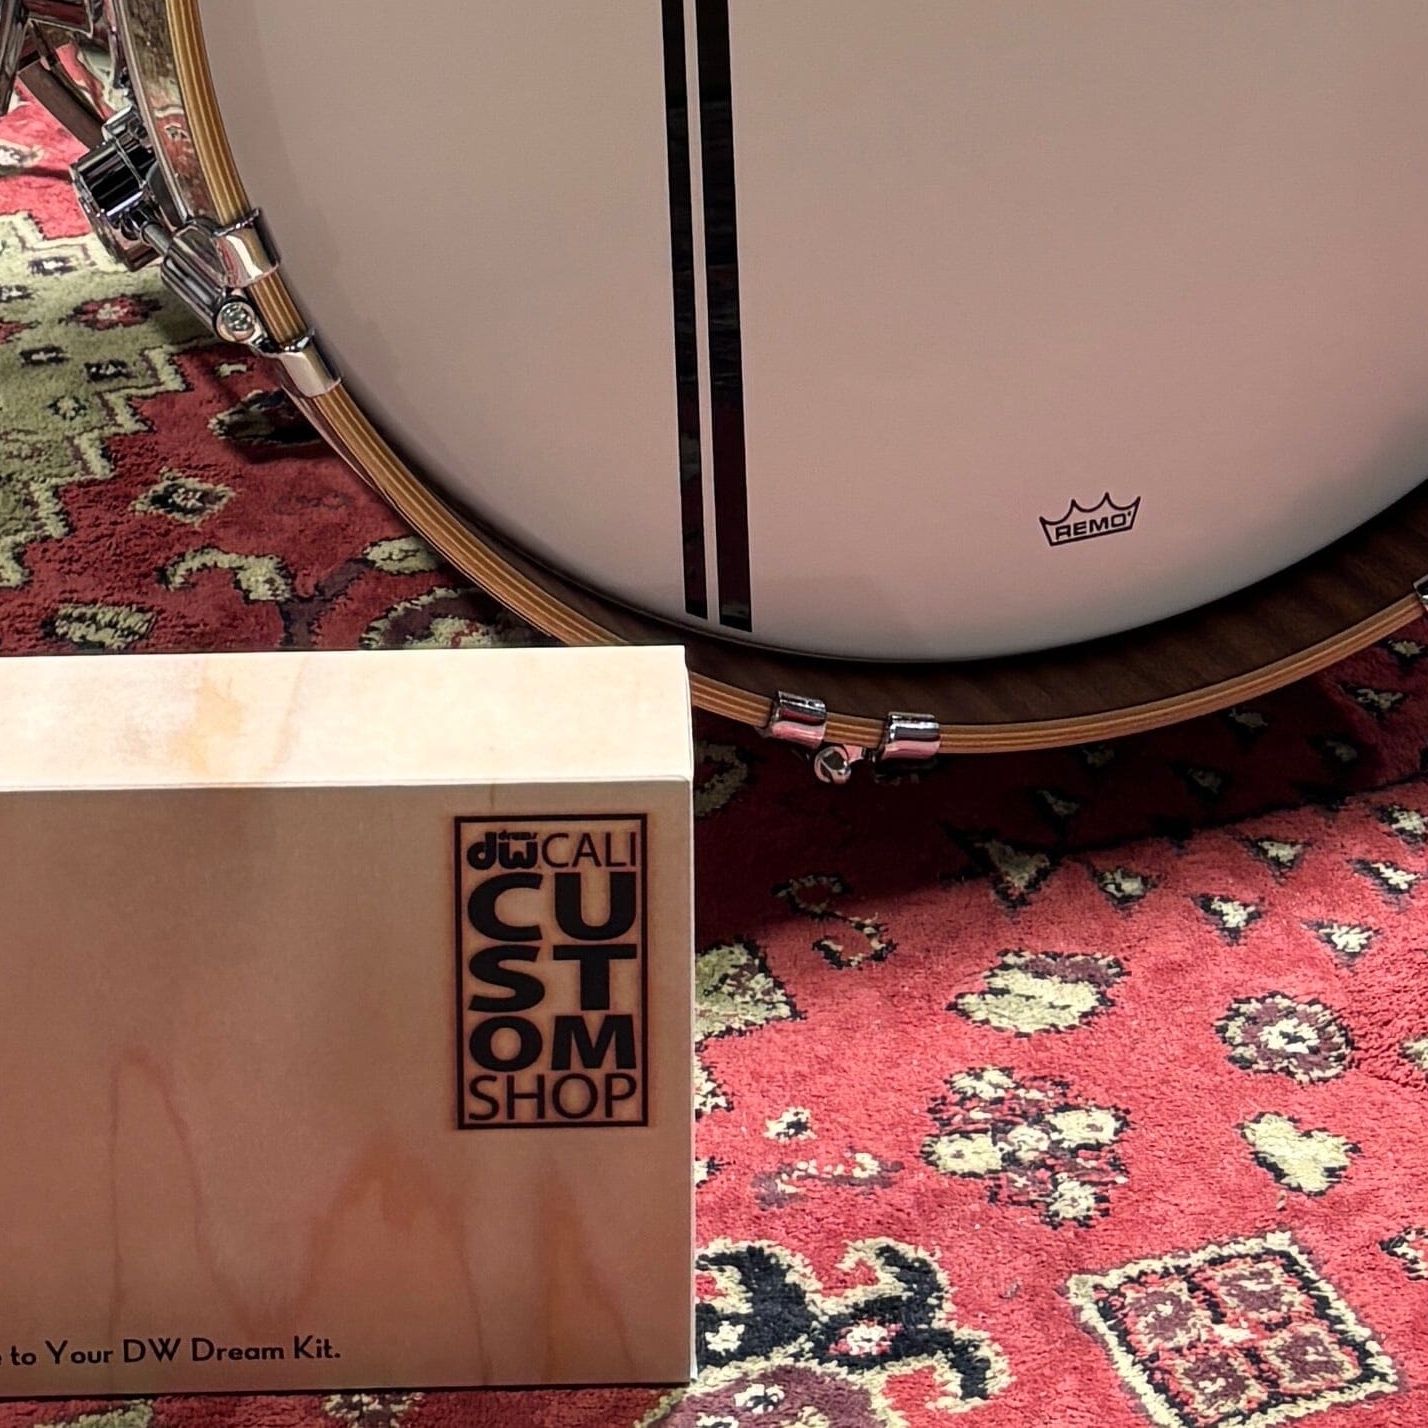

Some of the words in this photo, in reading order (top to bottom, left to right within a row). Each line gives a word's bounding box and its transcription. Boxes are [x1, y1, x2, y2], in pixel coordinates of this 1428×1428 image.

[1055, 513, 1127, 540] REMO
[467, 831, 539, 871] dw
[541, 832, 637, 867] CALI
[467, 871, 637, 943] CU
[468, 943, 637, 1013] ST
[469, 1014, 637, 1073] OM
[469, 1073, 637, 1122] SHOP
[11, 1345, 37, 1366] to
[45, 1340, 114, 1365] Your
[123, 1338, 182, 1363] DW
[191, 1337, 285, 1362] Dream
[293, 1334, 341, 1361] Kit.
